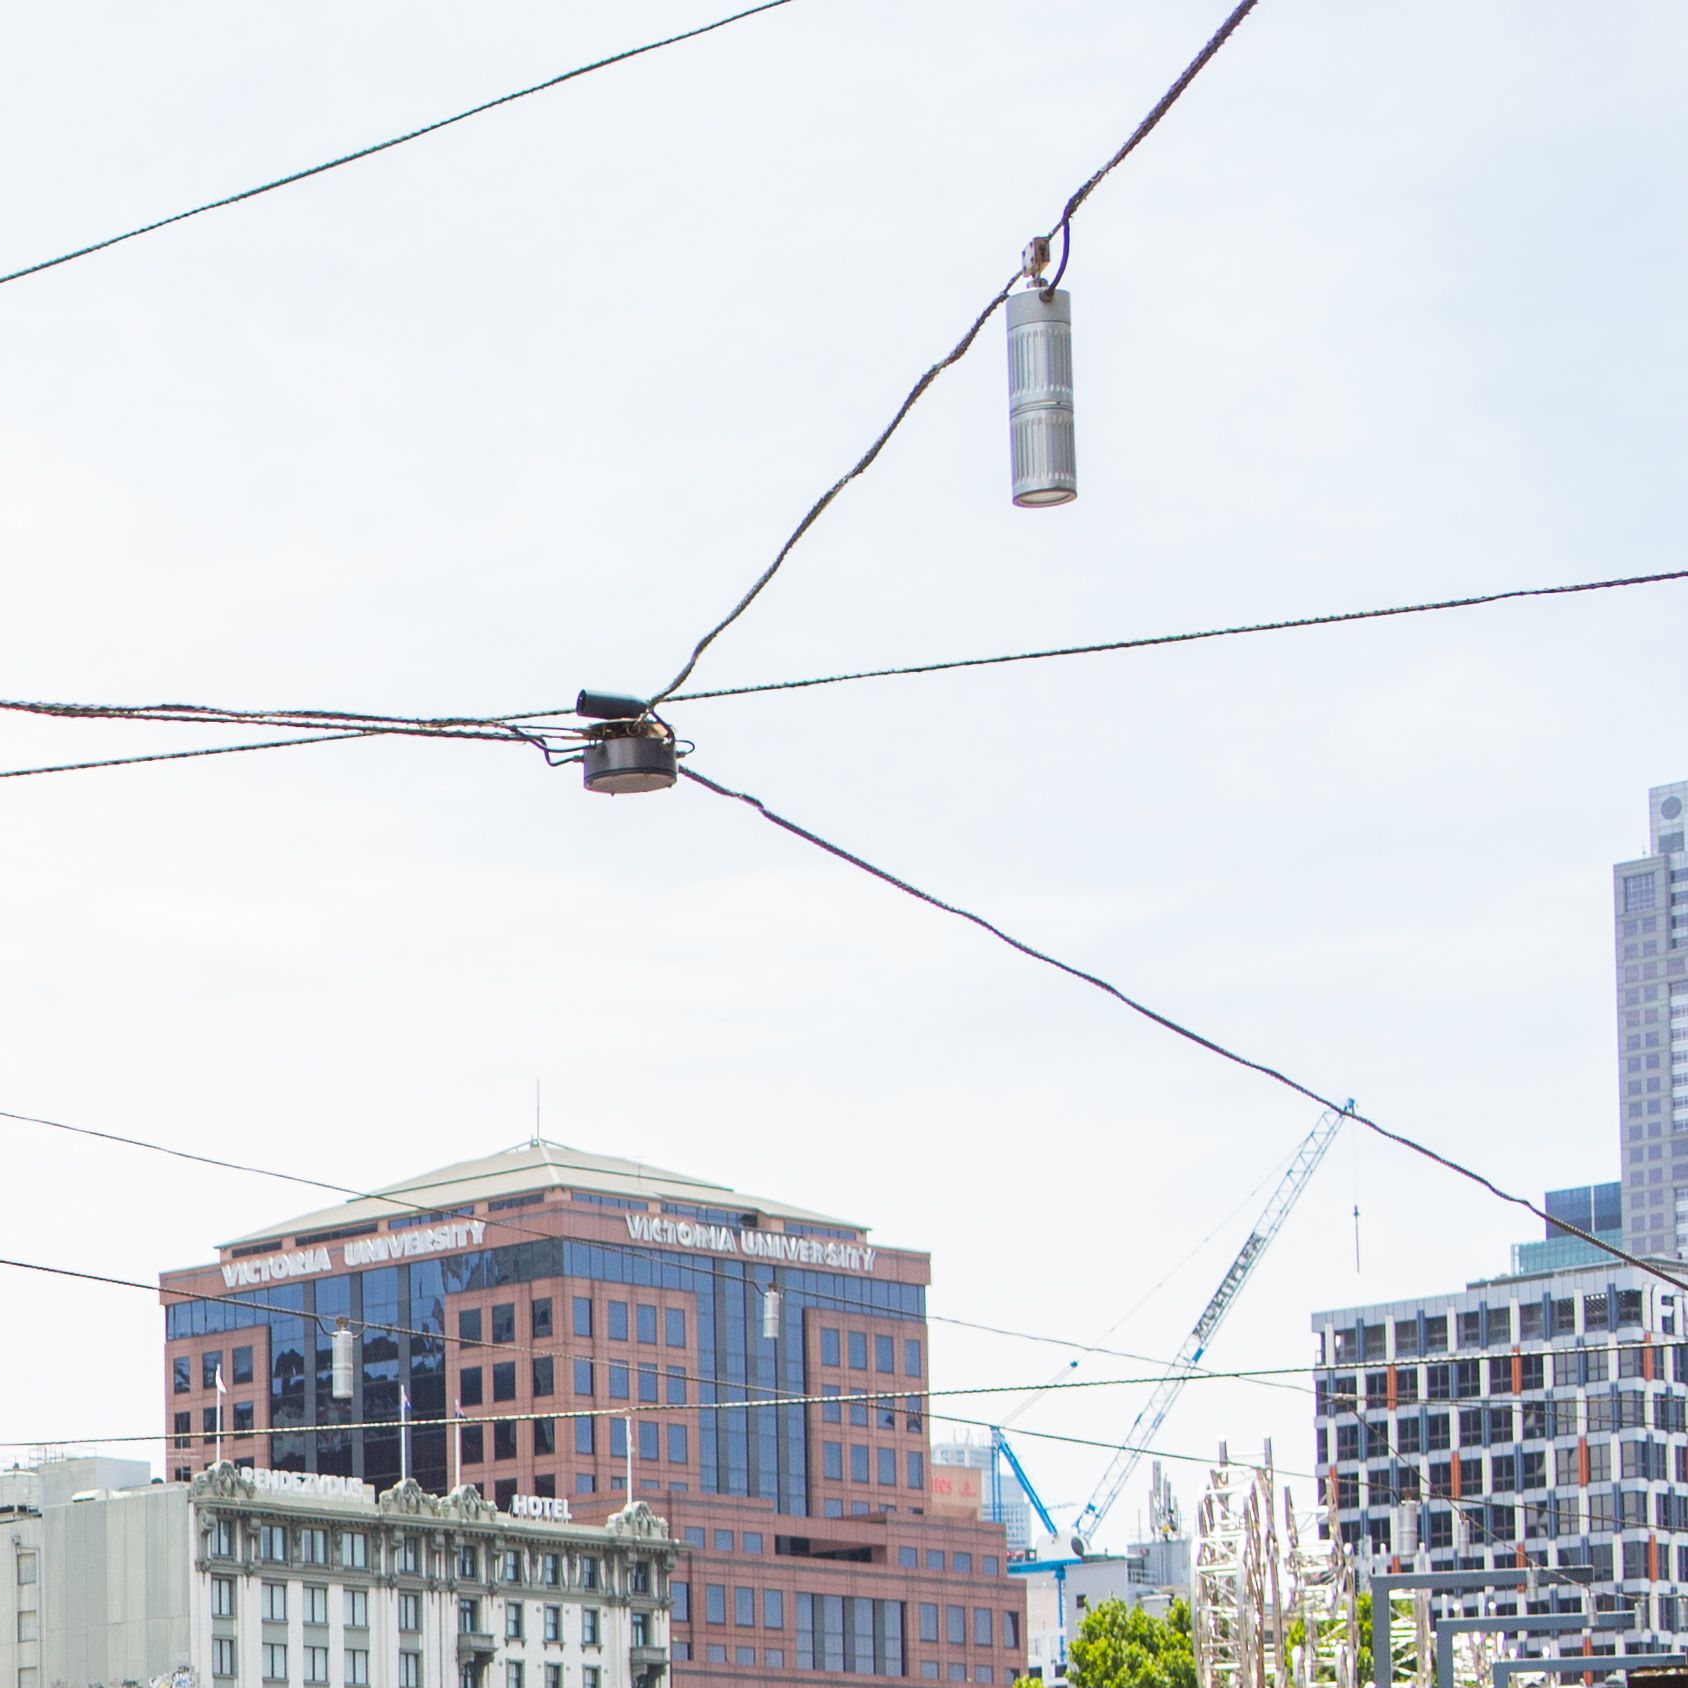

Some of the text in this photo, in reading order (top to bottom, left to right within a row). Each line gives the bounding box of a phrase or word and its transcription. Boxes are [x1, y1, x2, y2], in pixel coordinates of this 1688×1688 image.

[221, 1220, 486, 1288] VICTORIA UNIVERSITY
[625, 1214, 876, 1271] VICTORIA UNIVERSITY
[512, 1494, 572, 1521] HOTEL
